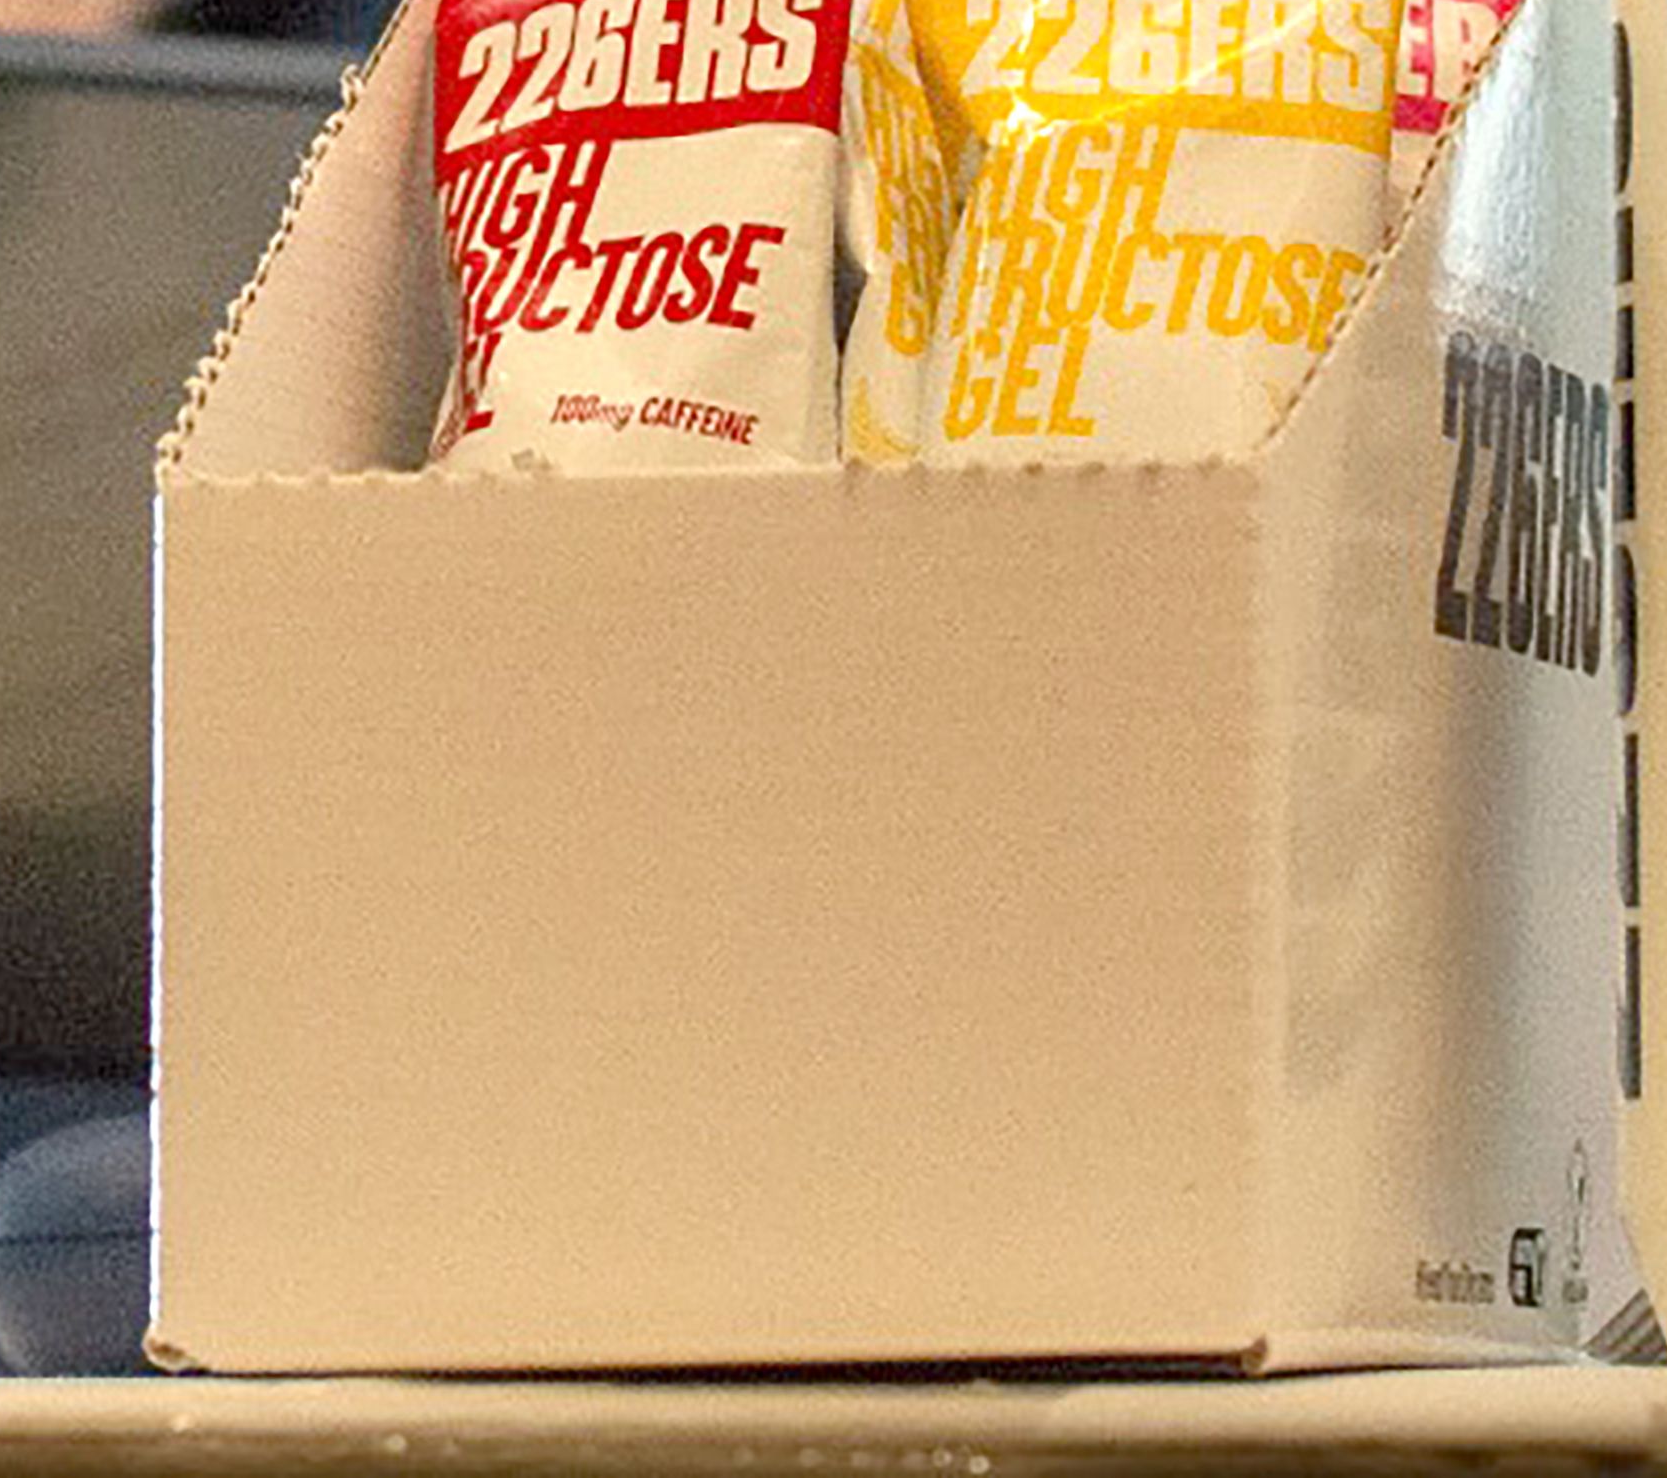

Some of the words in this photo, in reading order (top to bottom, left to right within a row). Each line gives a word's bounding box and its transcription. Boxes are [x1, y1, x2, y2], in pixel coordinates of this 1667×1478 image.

[550, 394, 635, 433] 100mg
[639, 396, 760, 446] CAFFEINE
[942, 326, 1095, 441] GEL
[1434, 330, 1609, 678] 226ERS
